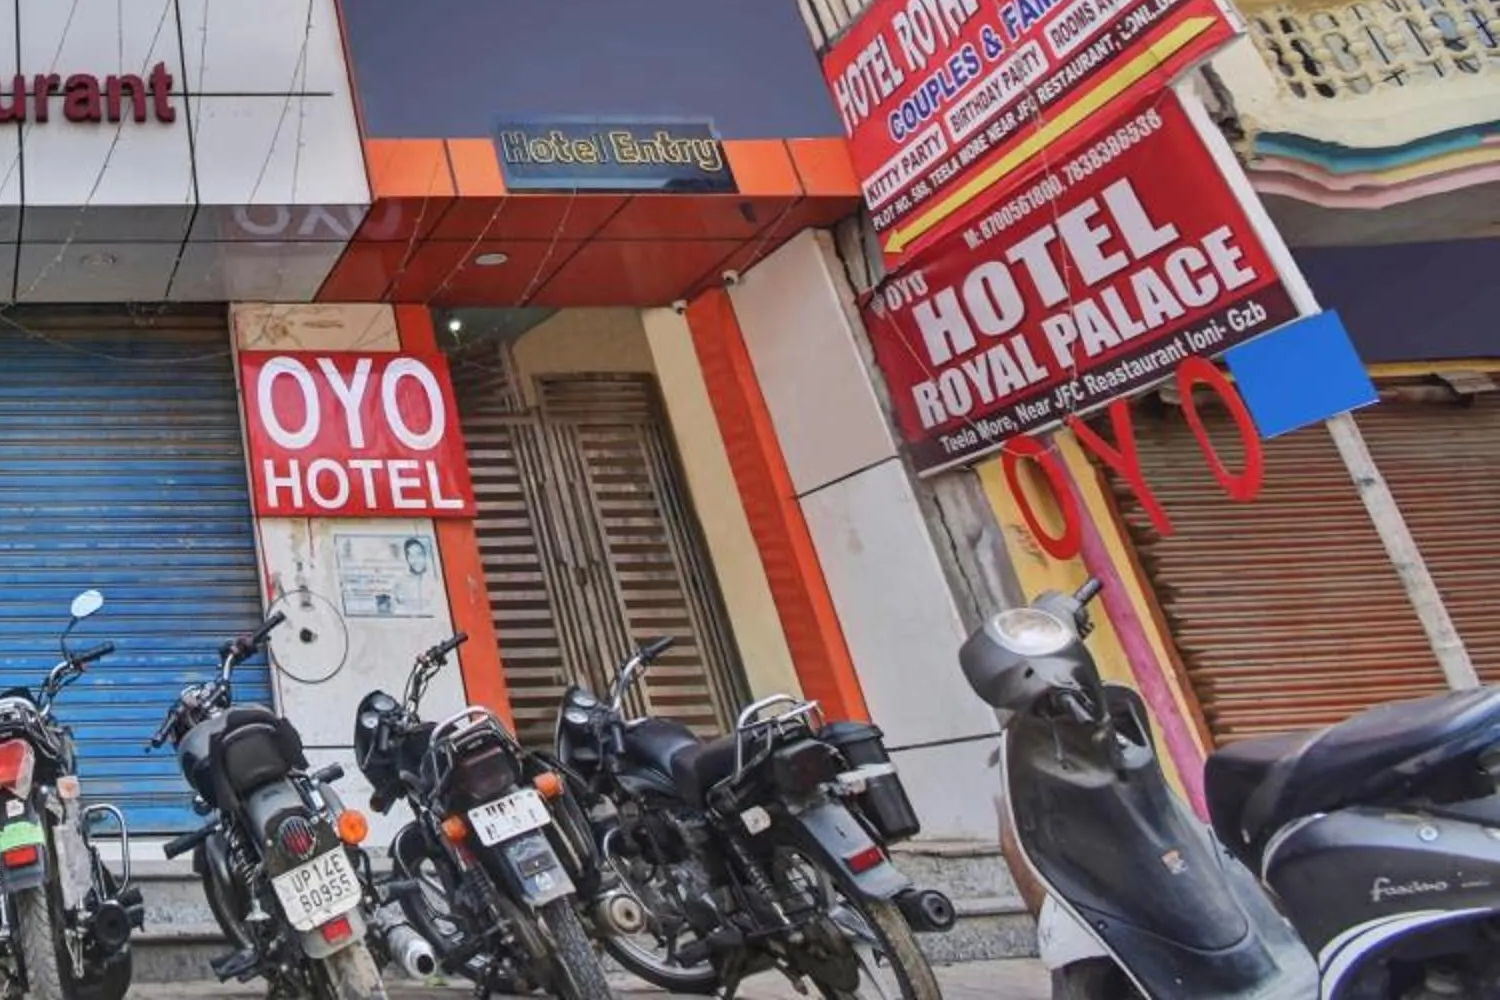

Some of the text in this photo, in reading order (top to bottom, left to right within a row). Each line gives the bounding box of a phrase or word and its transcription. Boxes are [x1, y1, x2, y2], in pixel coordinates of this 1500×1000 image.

[1049, 1, 1097, 49] ROOMS
[833, 33, 905, 140] HOTEL
[872, 207, 896, 232] PLOT
[930, 159, 962, 188] TEELA
[959, 134, 990, 166] MORE
[988, 112, 1019, 144] NEAR
[1036, 32, 1123, 104] RESTAURANT,
[888, 43, 980, 142] COUPLES
[980, 24, 1003, 62] &
[950, 48, 1040, 134] BIRTHDAY PARTY
[501, 130, 722, 171] Hotel Entry
[866, 130, 942, 203] KITTY PARTY
[912, 177, 1179, 366] HOTEL
[911, 226, 1256, 429] ROYAL PALACE
[940, 429, 978, 453] Teela
[976, 413, 1018, 440] More,
[1015, 398, 1051, 424] Near
[1055, 380, 1084, 409] JFC
[1083, 336, 1188, 395] Reastaurant
[1227, 300, 1267, 333] Gzb
[257, 356, 446, 451] OYO
[262, 459, 465, 510] HOTEL
[1002, 357, 1263, 560] OYO
